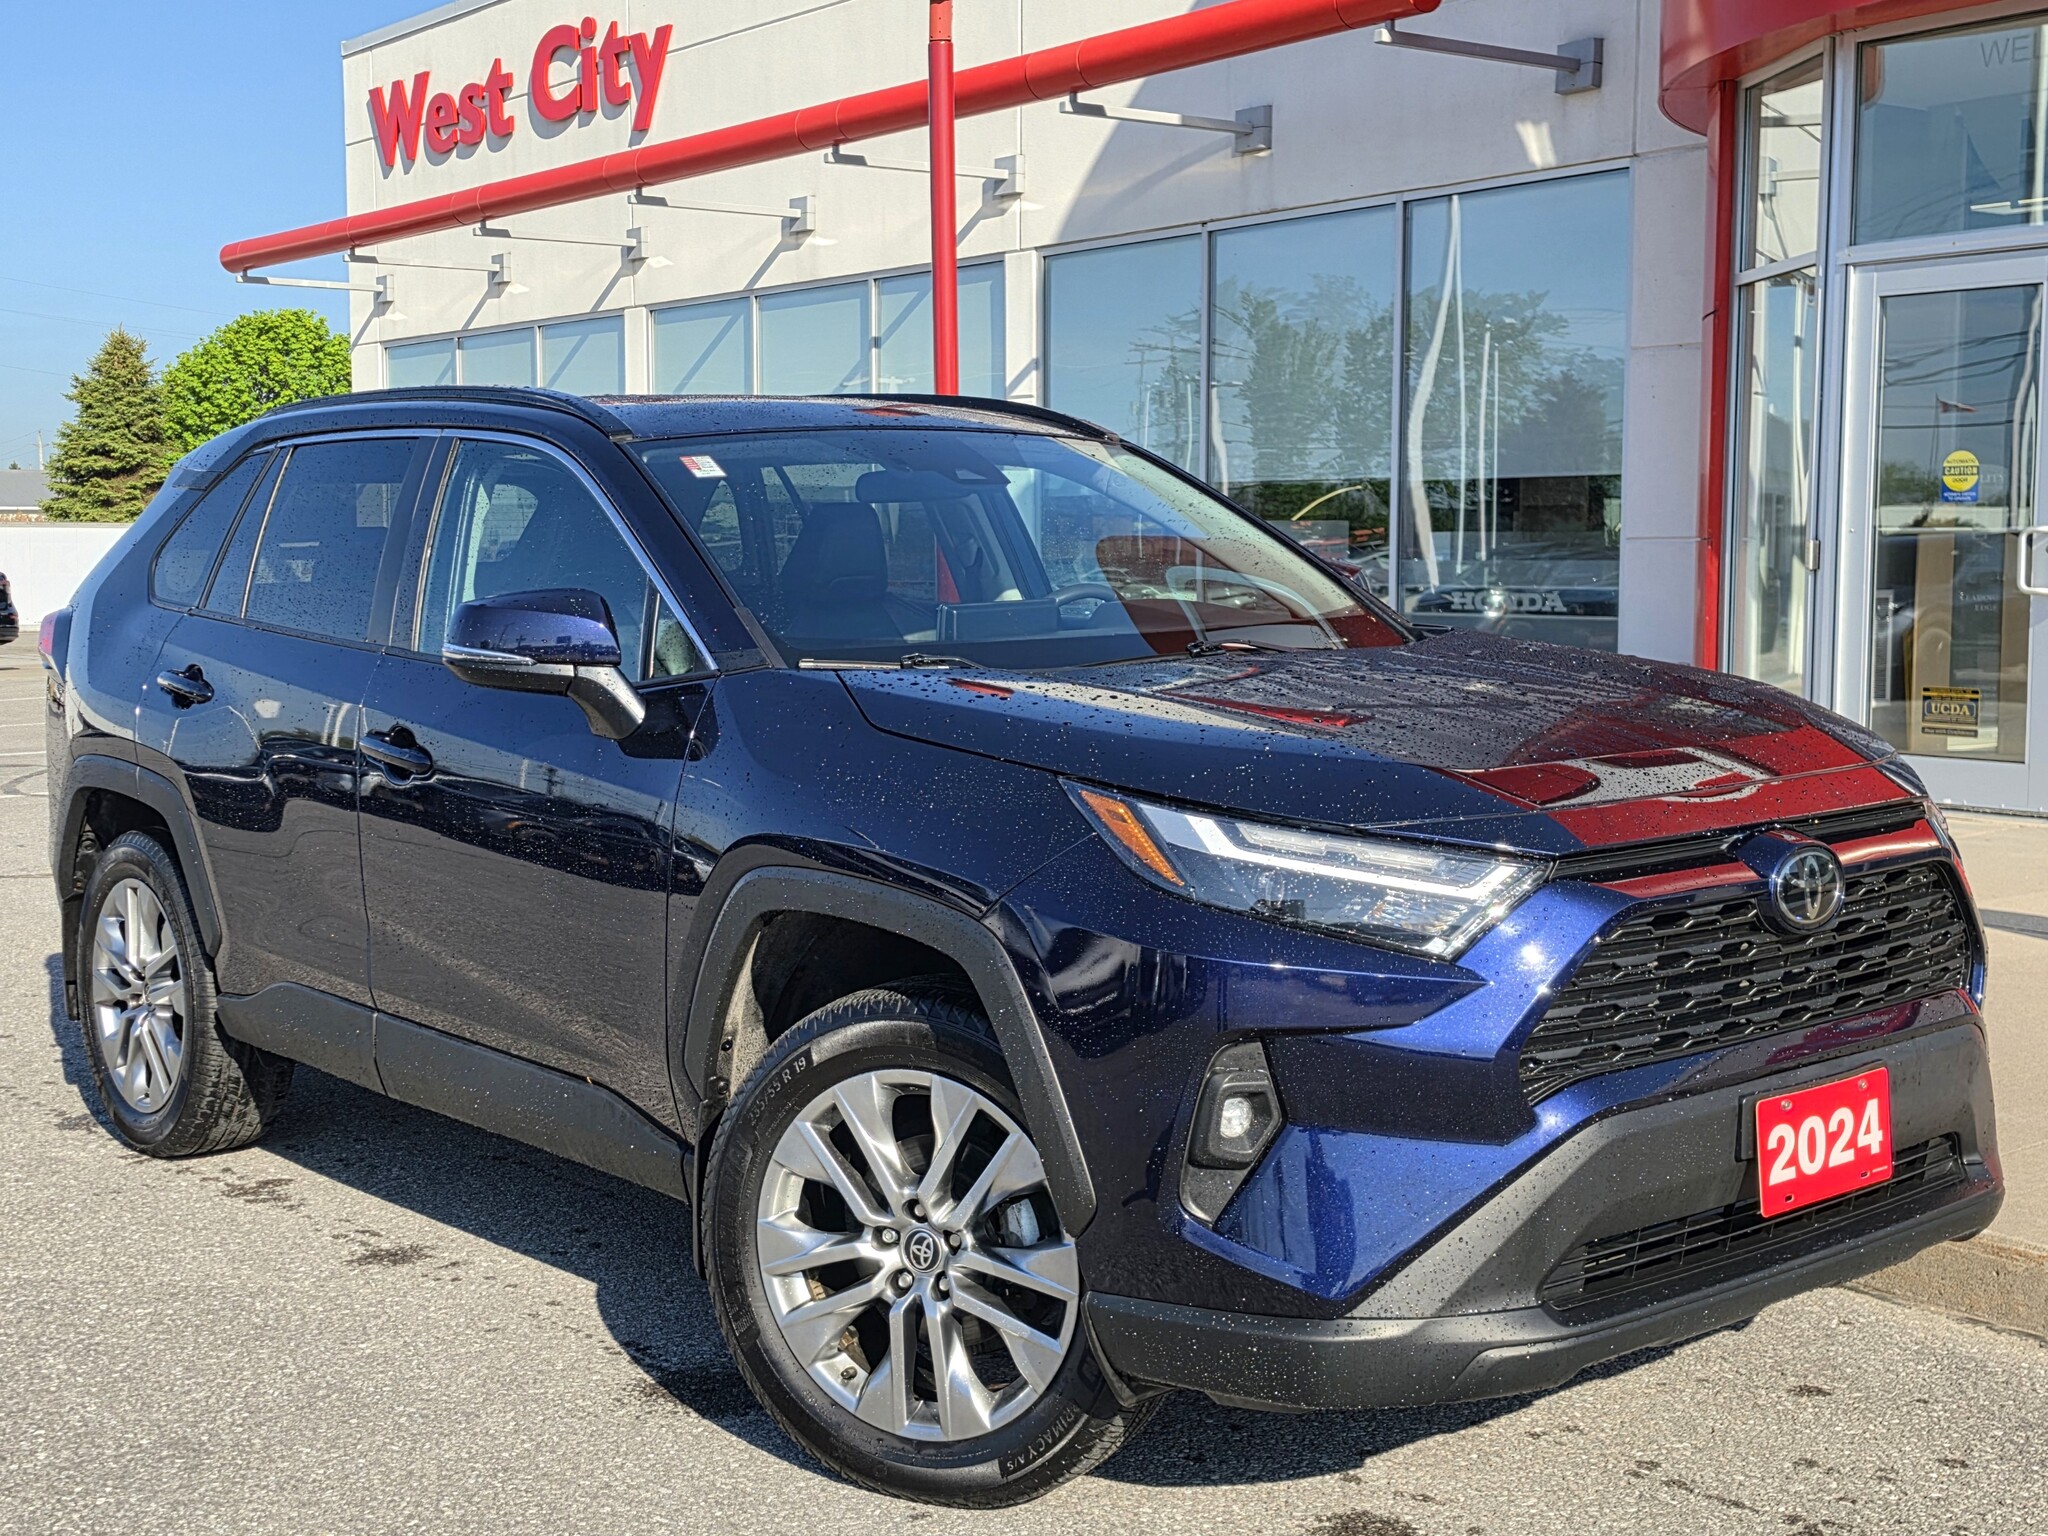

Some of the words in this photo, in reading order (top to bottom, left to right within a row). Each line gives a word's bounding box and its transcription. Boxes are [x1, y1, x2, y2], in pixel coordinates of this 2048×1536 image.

[368, 57, 514, 167] West
[530, 16, 673, 131] City
[1945, 466, 1977, 475] CAUTION
[1450, 590, 1567, 613] HONDA
[1931, 702, 1970, 716] UCDA
[781, 1068, 792, 1084] R
[793, 1056, 807, 1073] 19
[1767, 1098, 1883, 1187] 2024
